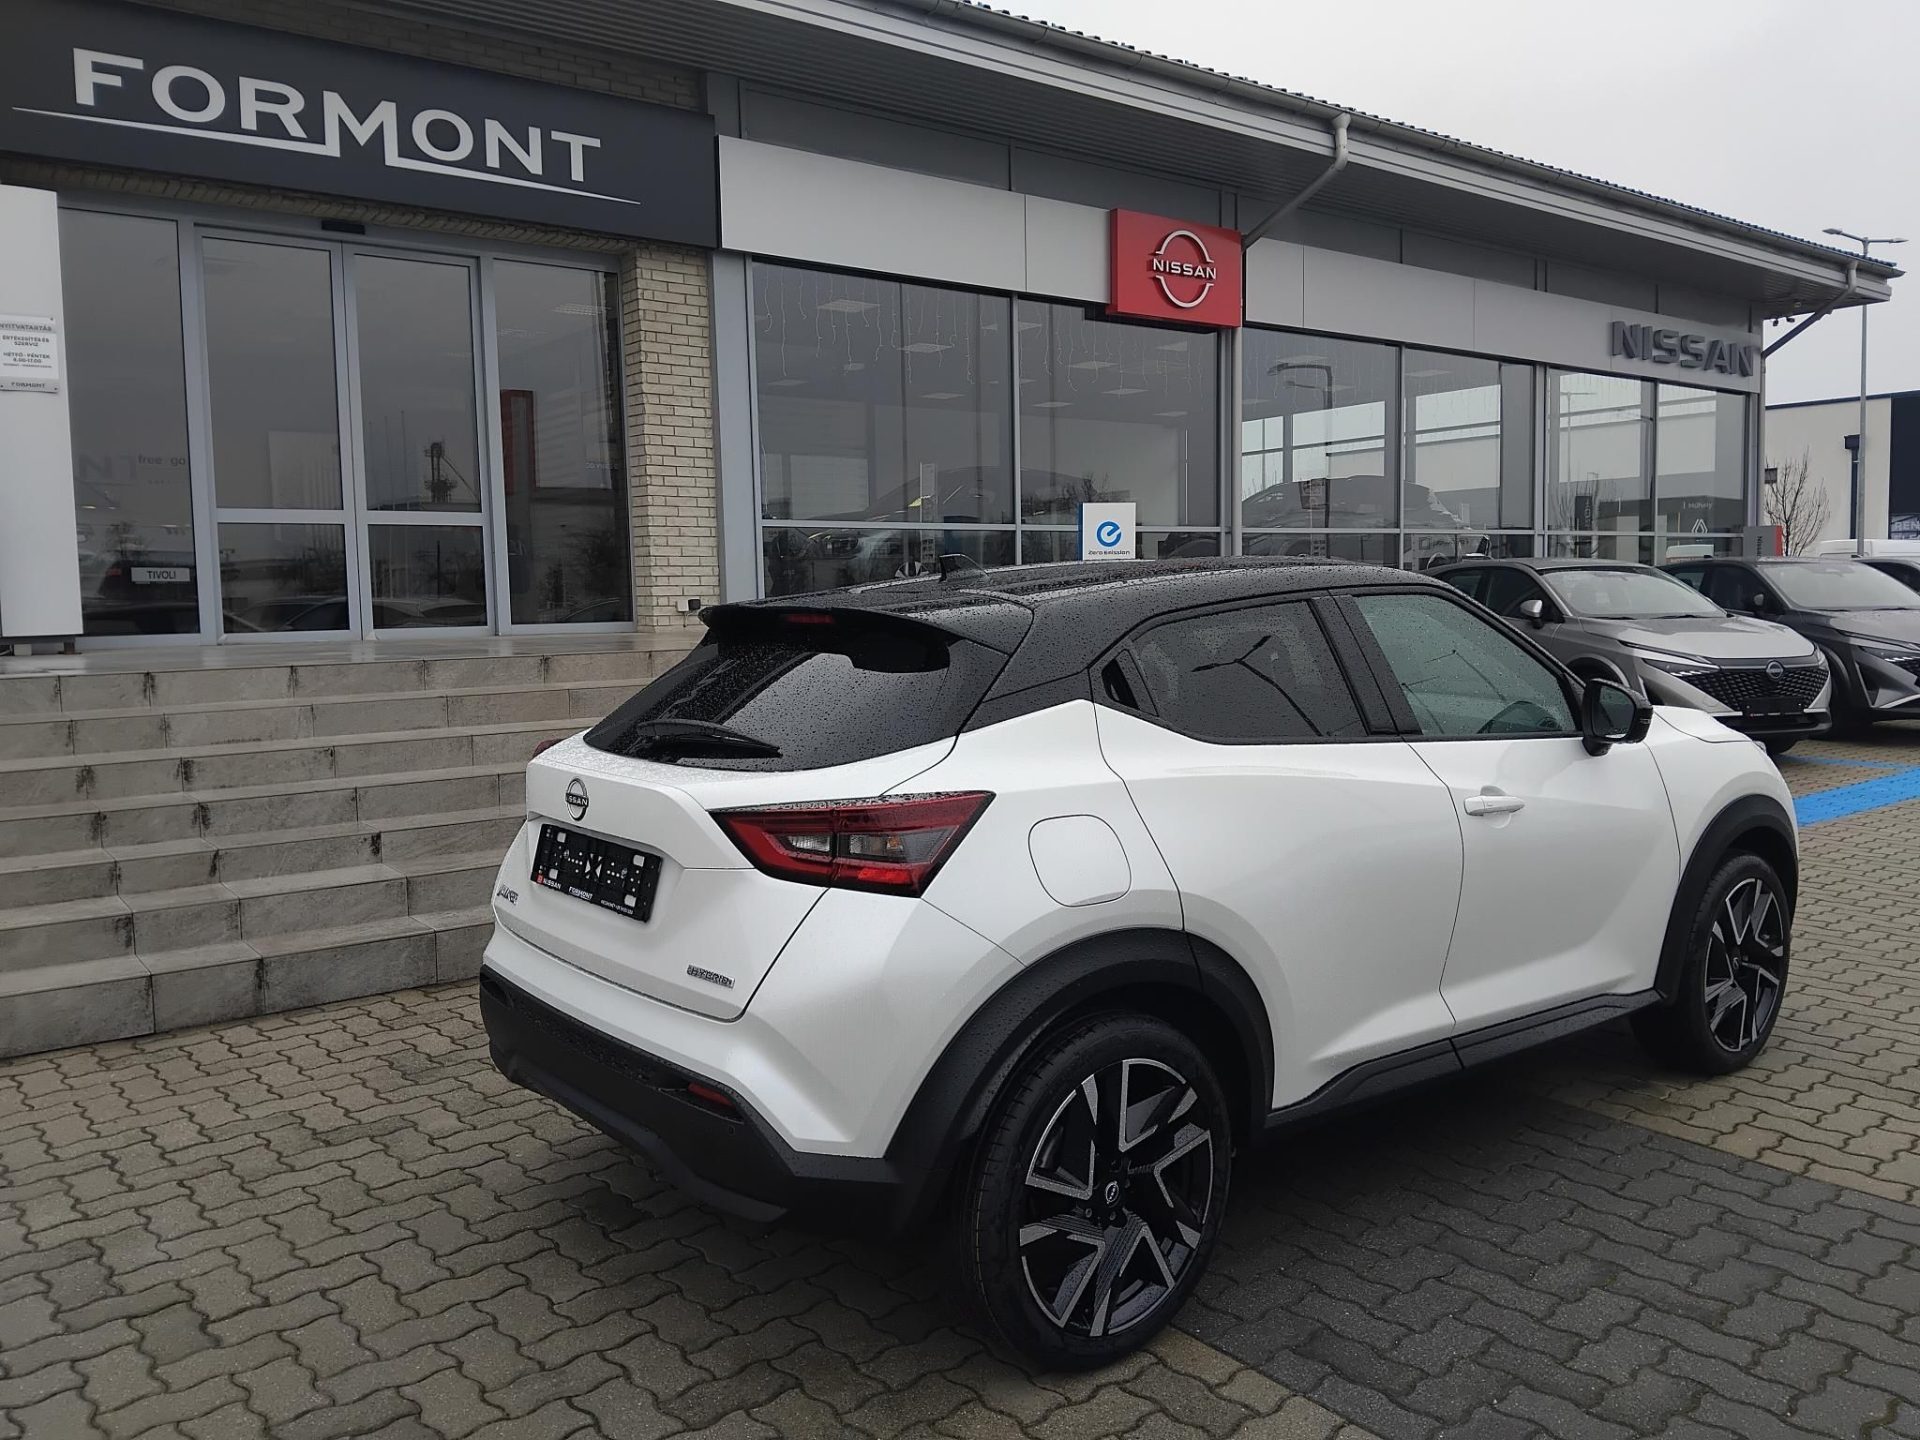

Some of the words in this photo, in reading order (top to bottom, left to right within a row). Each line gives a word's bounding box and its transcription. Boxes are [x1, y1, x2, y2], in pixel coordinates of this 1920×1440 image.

[72, 46, 602, 184] FORMONT
[1153, 257, 1217, 280] NISSAN
[1611, 320, 1754, 378] NISSAN
[146, 570, 177, 580] TIVOLI
[568, 886, 593, 901] FORMONT
